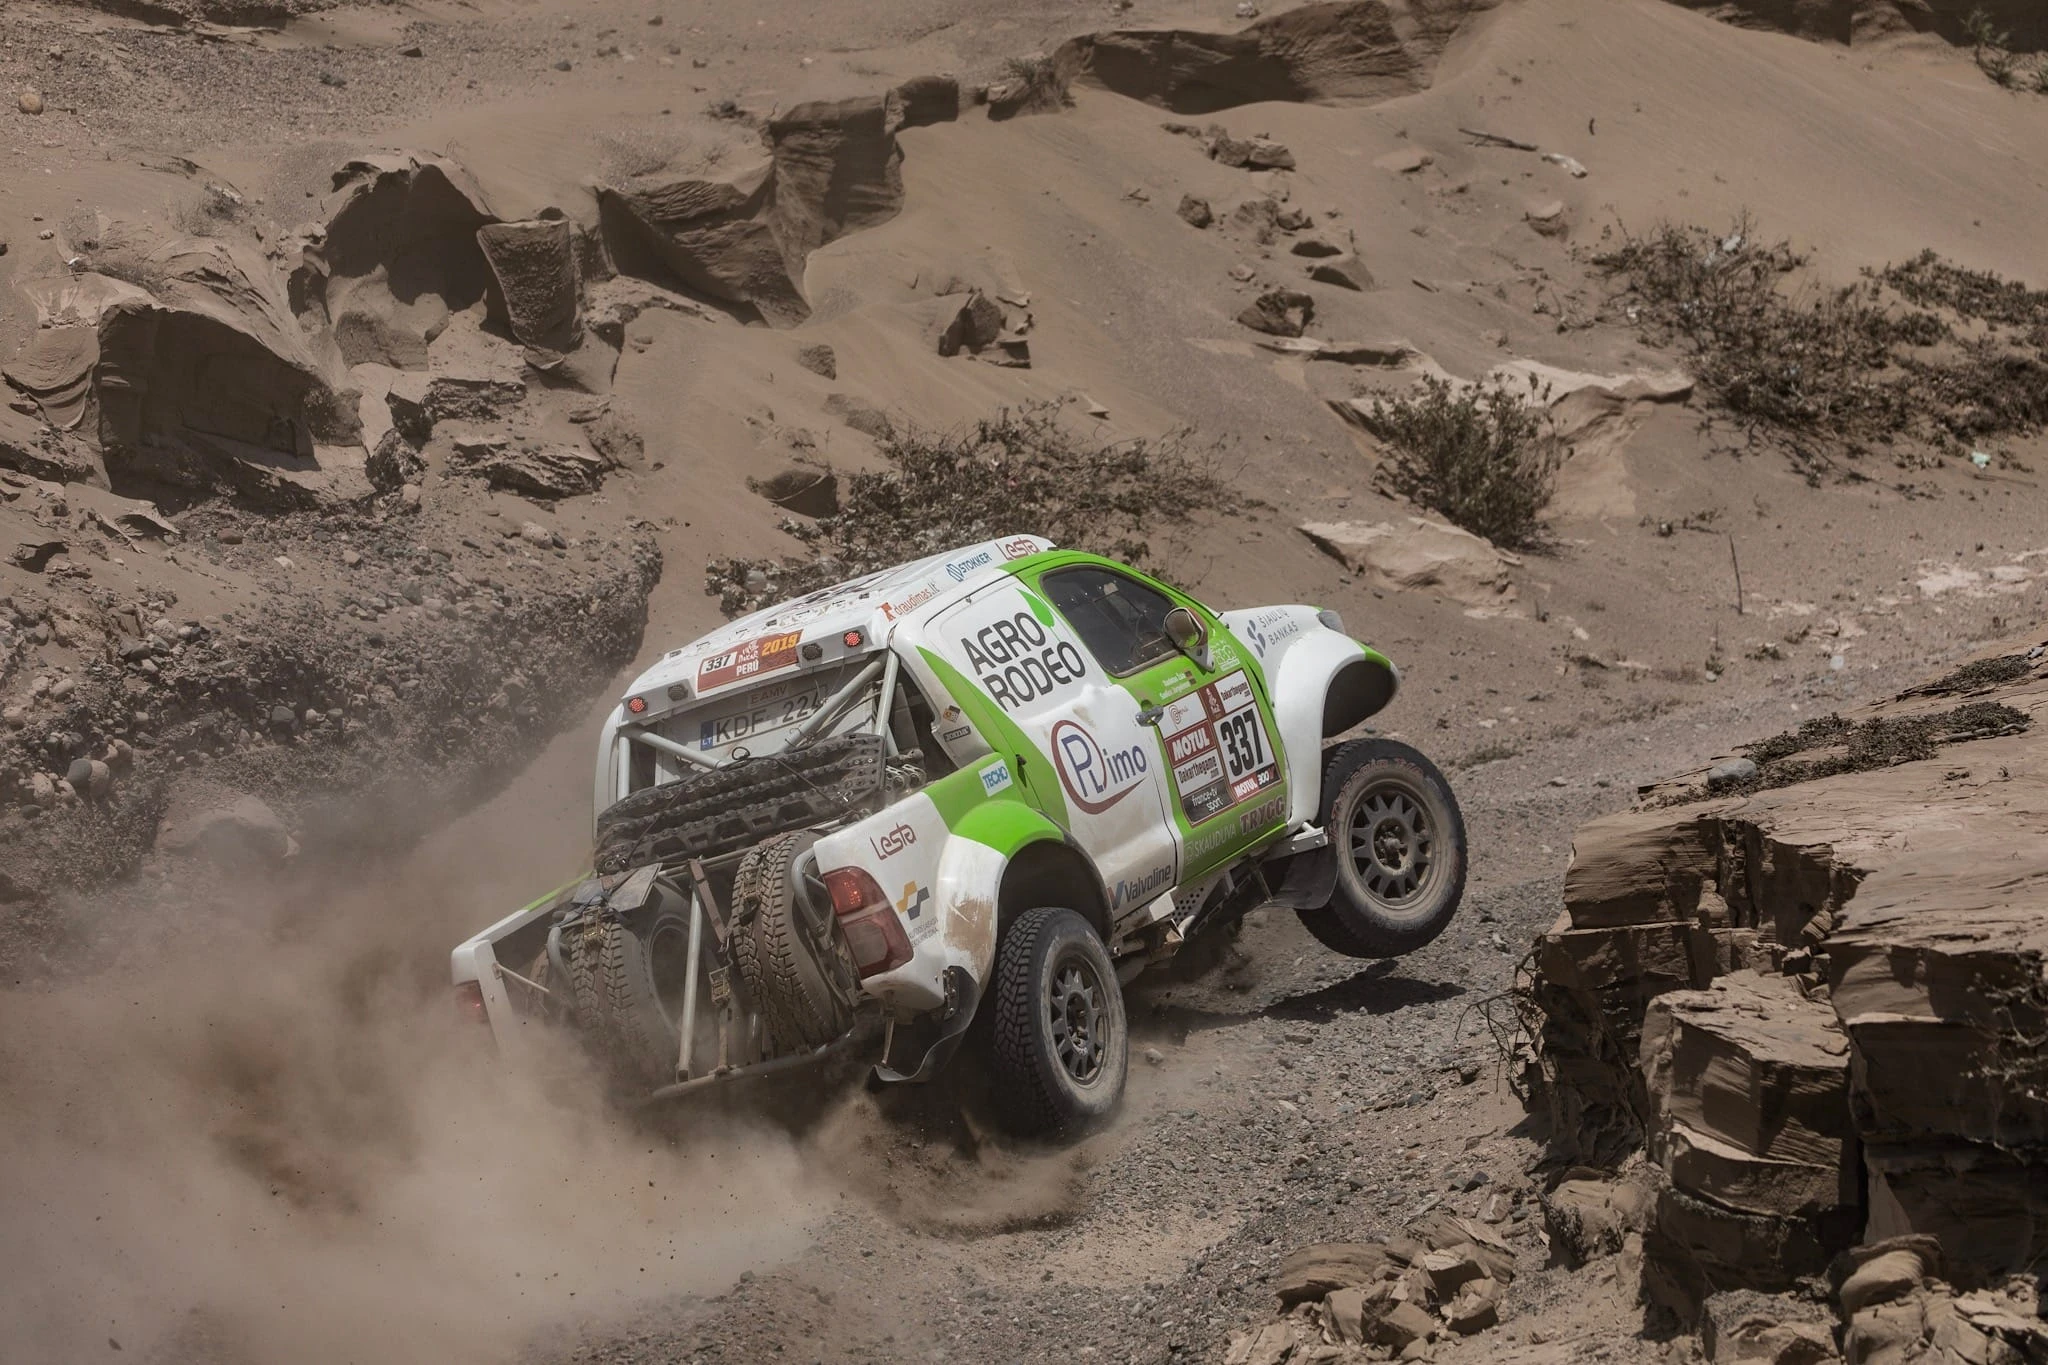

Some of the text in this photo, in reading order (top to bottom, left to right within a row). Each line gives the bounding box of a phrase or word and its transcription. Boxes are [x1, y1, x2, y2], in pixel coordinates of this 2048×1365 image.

[959, 552, 992, 573] STOKKER
[894, 579, 940, 615] draudimas.lt
[761, 634, 798, 656] 2019
[960, 612, 1046, 676] AGRO
[1268, 621, 1299, 645] BANKAS
[706, 654, 731, 671] 337
[982, 641, 1086, 713] RODEO
[716, 708, 767, 742] KDF
[702, 737, 713, 746] LT
[1172, 727, 1211, 762] MOTUL
[1220, 708, 1264, 777] 337
[1234, 778, 1258, 798] MOTUL
[1206, 797, 1224, 813] sport
[1124, 865, 1171, 903] Valvoline
